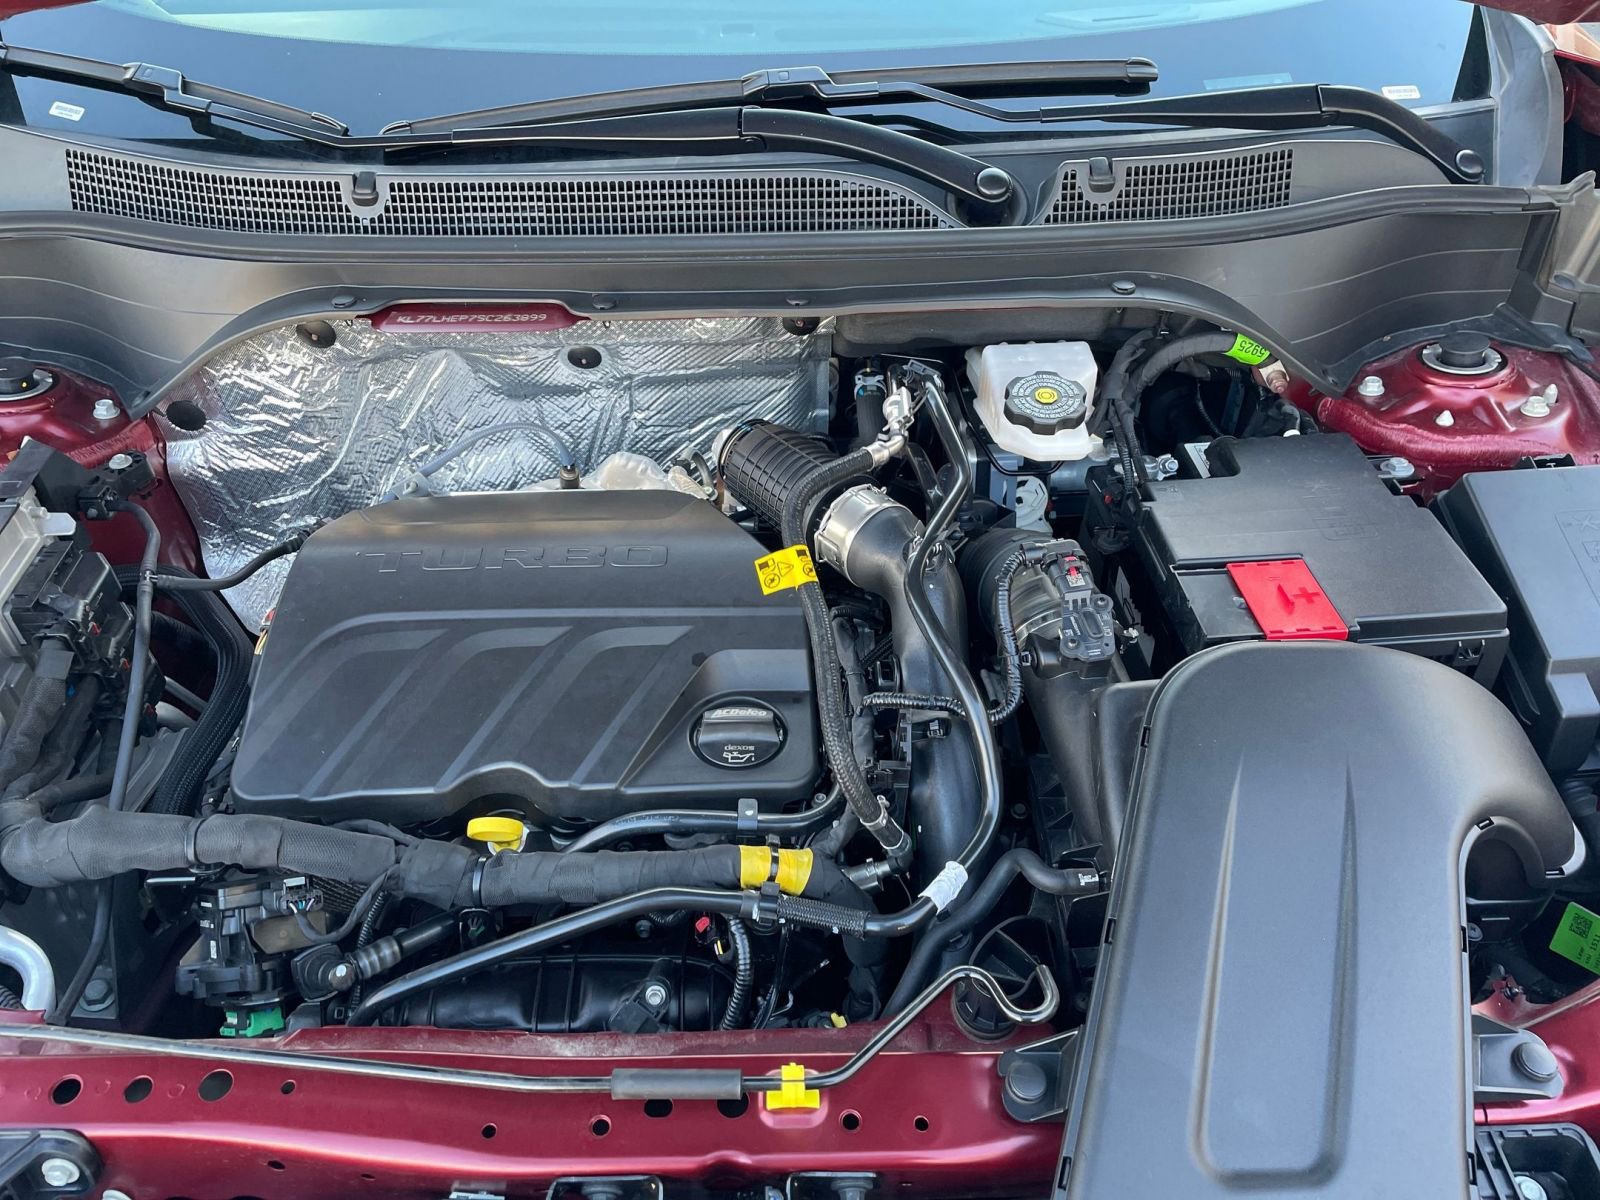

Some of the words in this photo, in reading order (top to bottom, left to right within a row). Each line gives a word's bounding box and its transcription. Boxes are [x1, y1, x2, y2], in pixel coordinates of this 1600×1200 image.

[1237, 340, 1266, 358] 5925
[363, 544, 669, 573] TURBO
[710, 708, 767, 719] ACDelco
